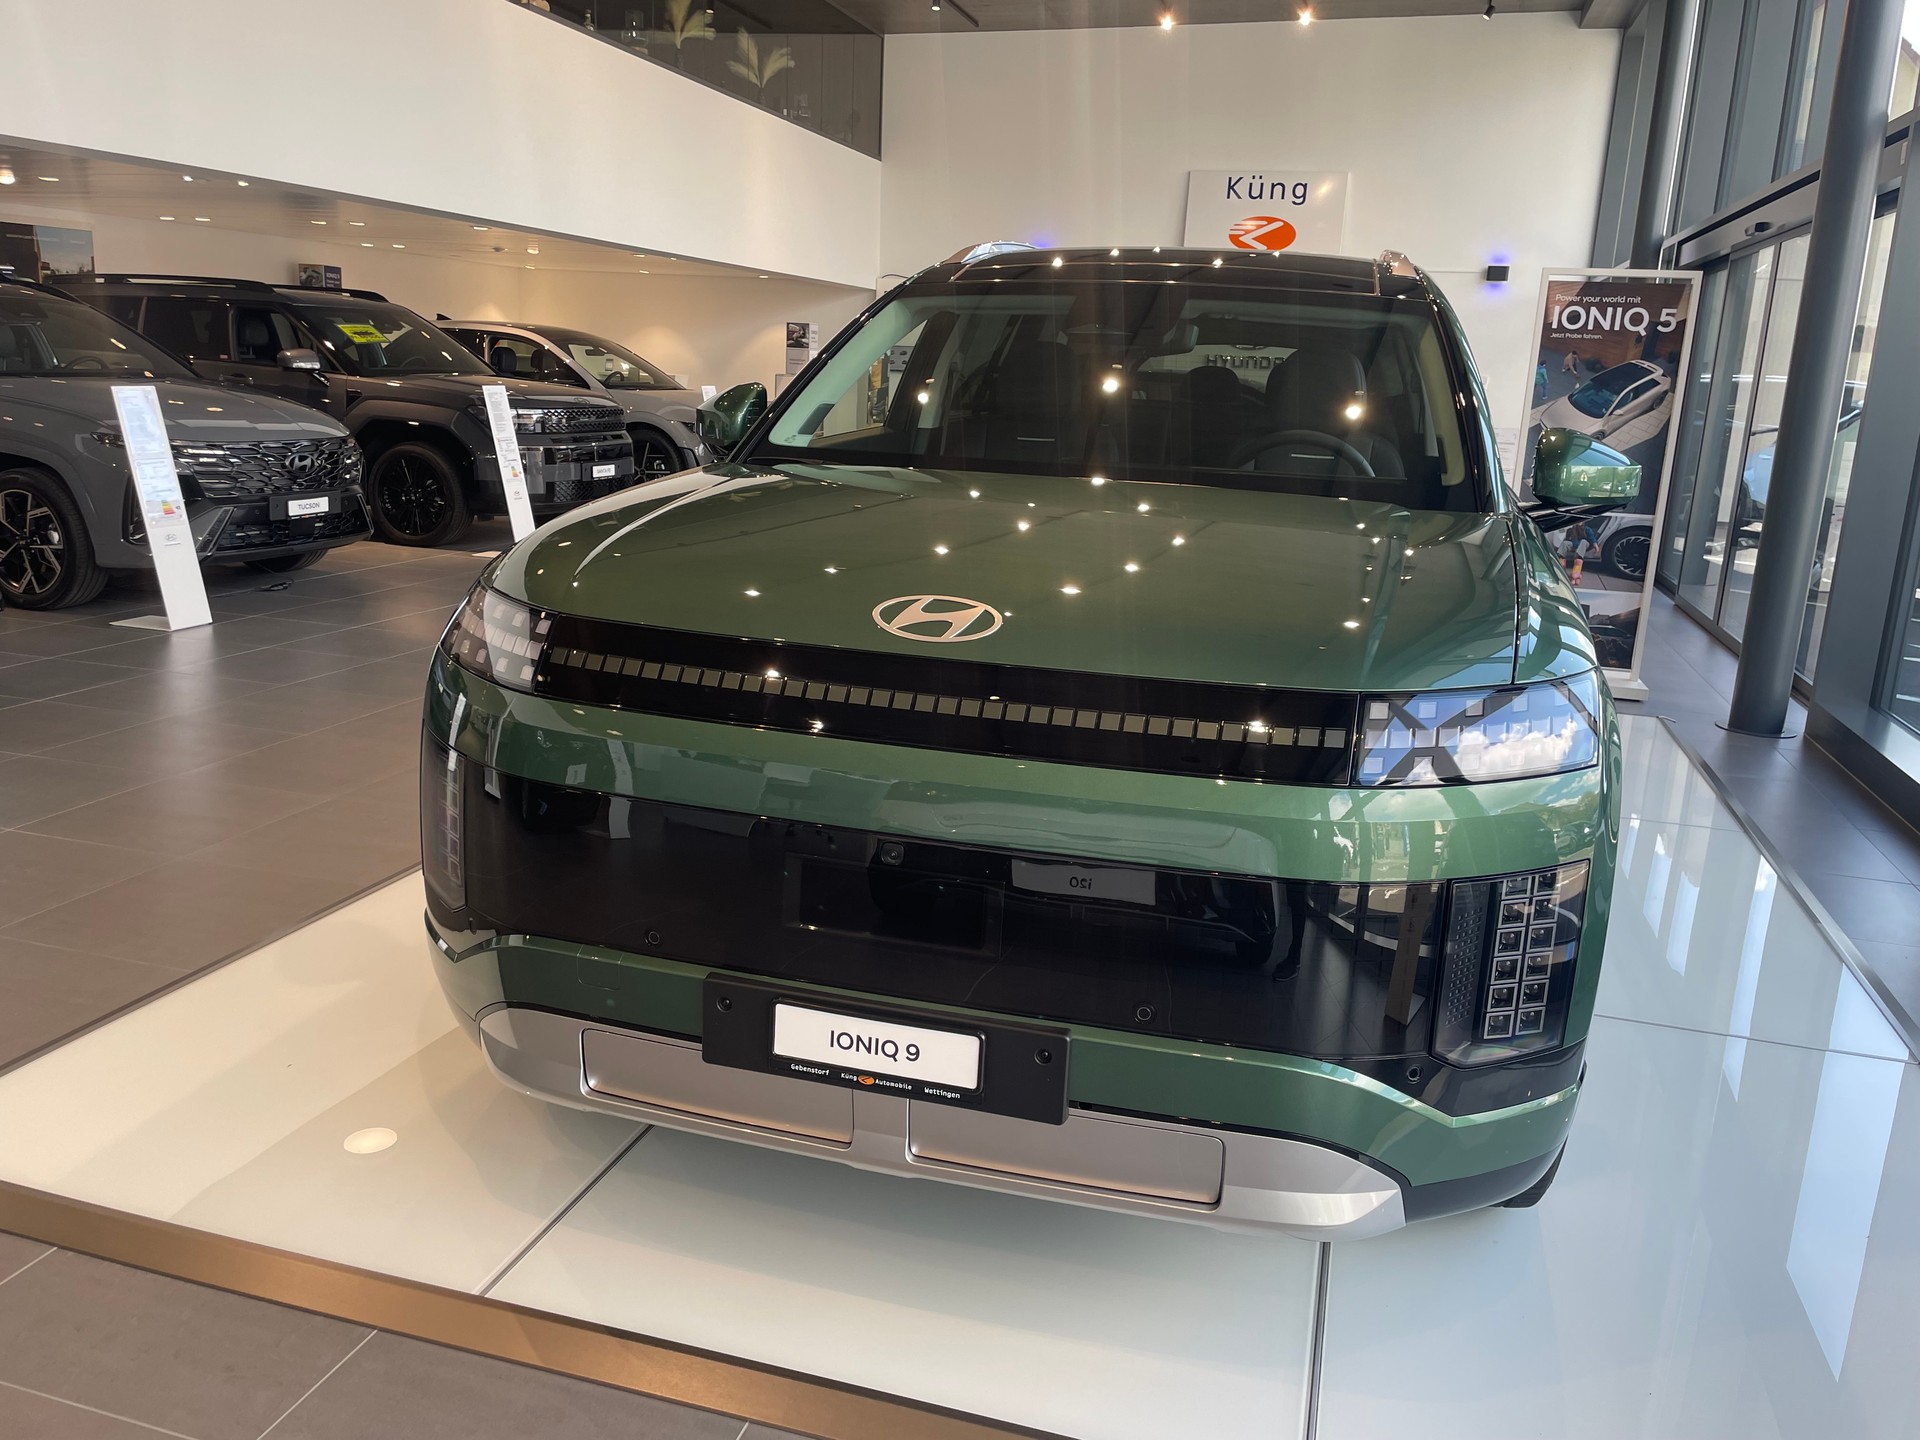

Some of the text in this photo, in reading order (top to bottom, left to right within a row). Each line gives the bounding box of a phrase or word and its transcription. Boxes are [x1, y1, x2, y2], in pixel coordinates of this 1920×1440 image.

[1226, 175, 1308, 206] Küng
[1555, 294, 1641, 304] Power your world mit
[1551, 305, 1678, 337] IONIQ 5
[1206, 354, 1286, 369] HYUND
[297, 502, 320, 510] TUCSON
[829, 1030, 921, 1062] IONIQ 9
[790, 1063, 961, 1099] Gebenstorf Küng Automobile Wettingen
